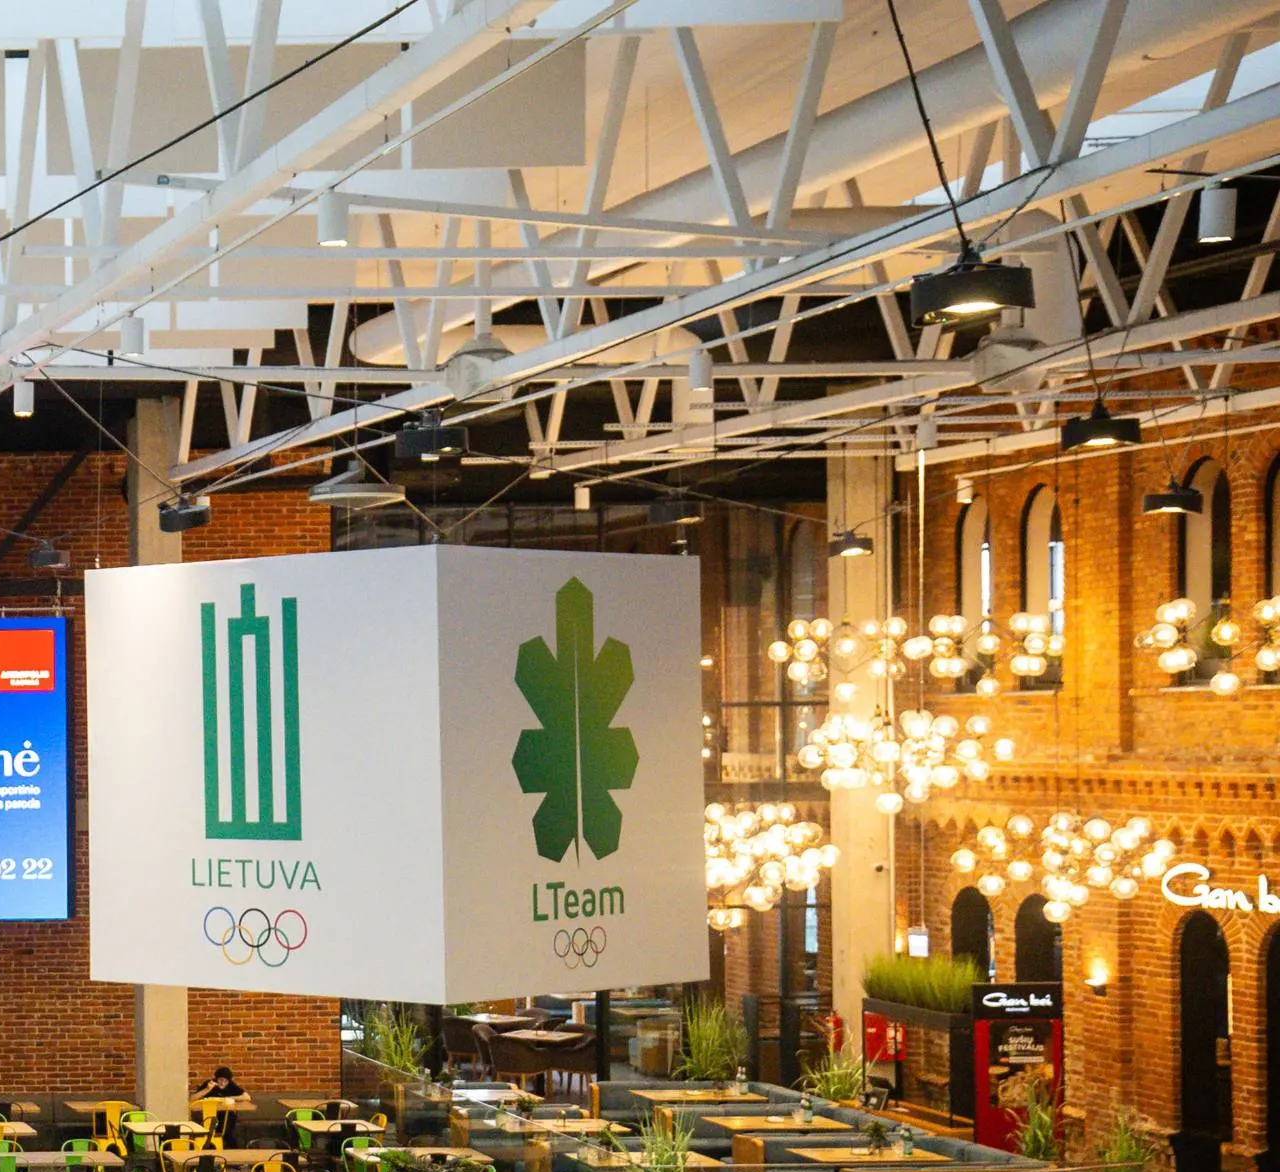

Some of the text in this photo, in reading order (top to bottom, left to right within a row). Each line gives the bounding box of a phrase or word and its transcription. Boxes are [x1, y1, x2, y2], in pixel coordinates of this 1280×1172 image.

[4, 798, 40, 811] paroda
[22, 857, 53, 880] 22
[191, 858, 322, 891] LIETUVA
[532, 882, 625, 922] LTeam
